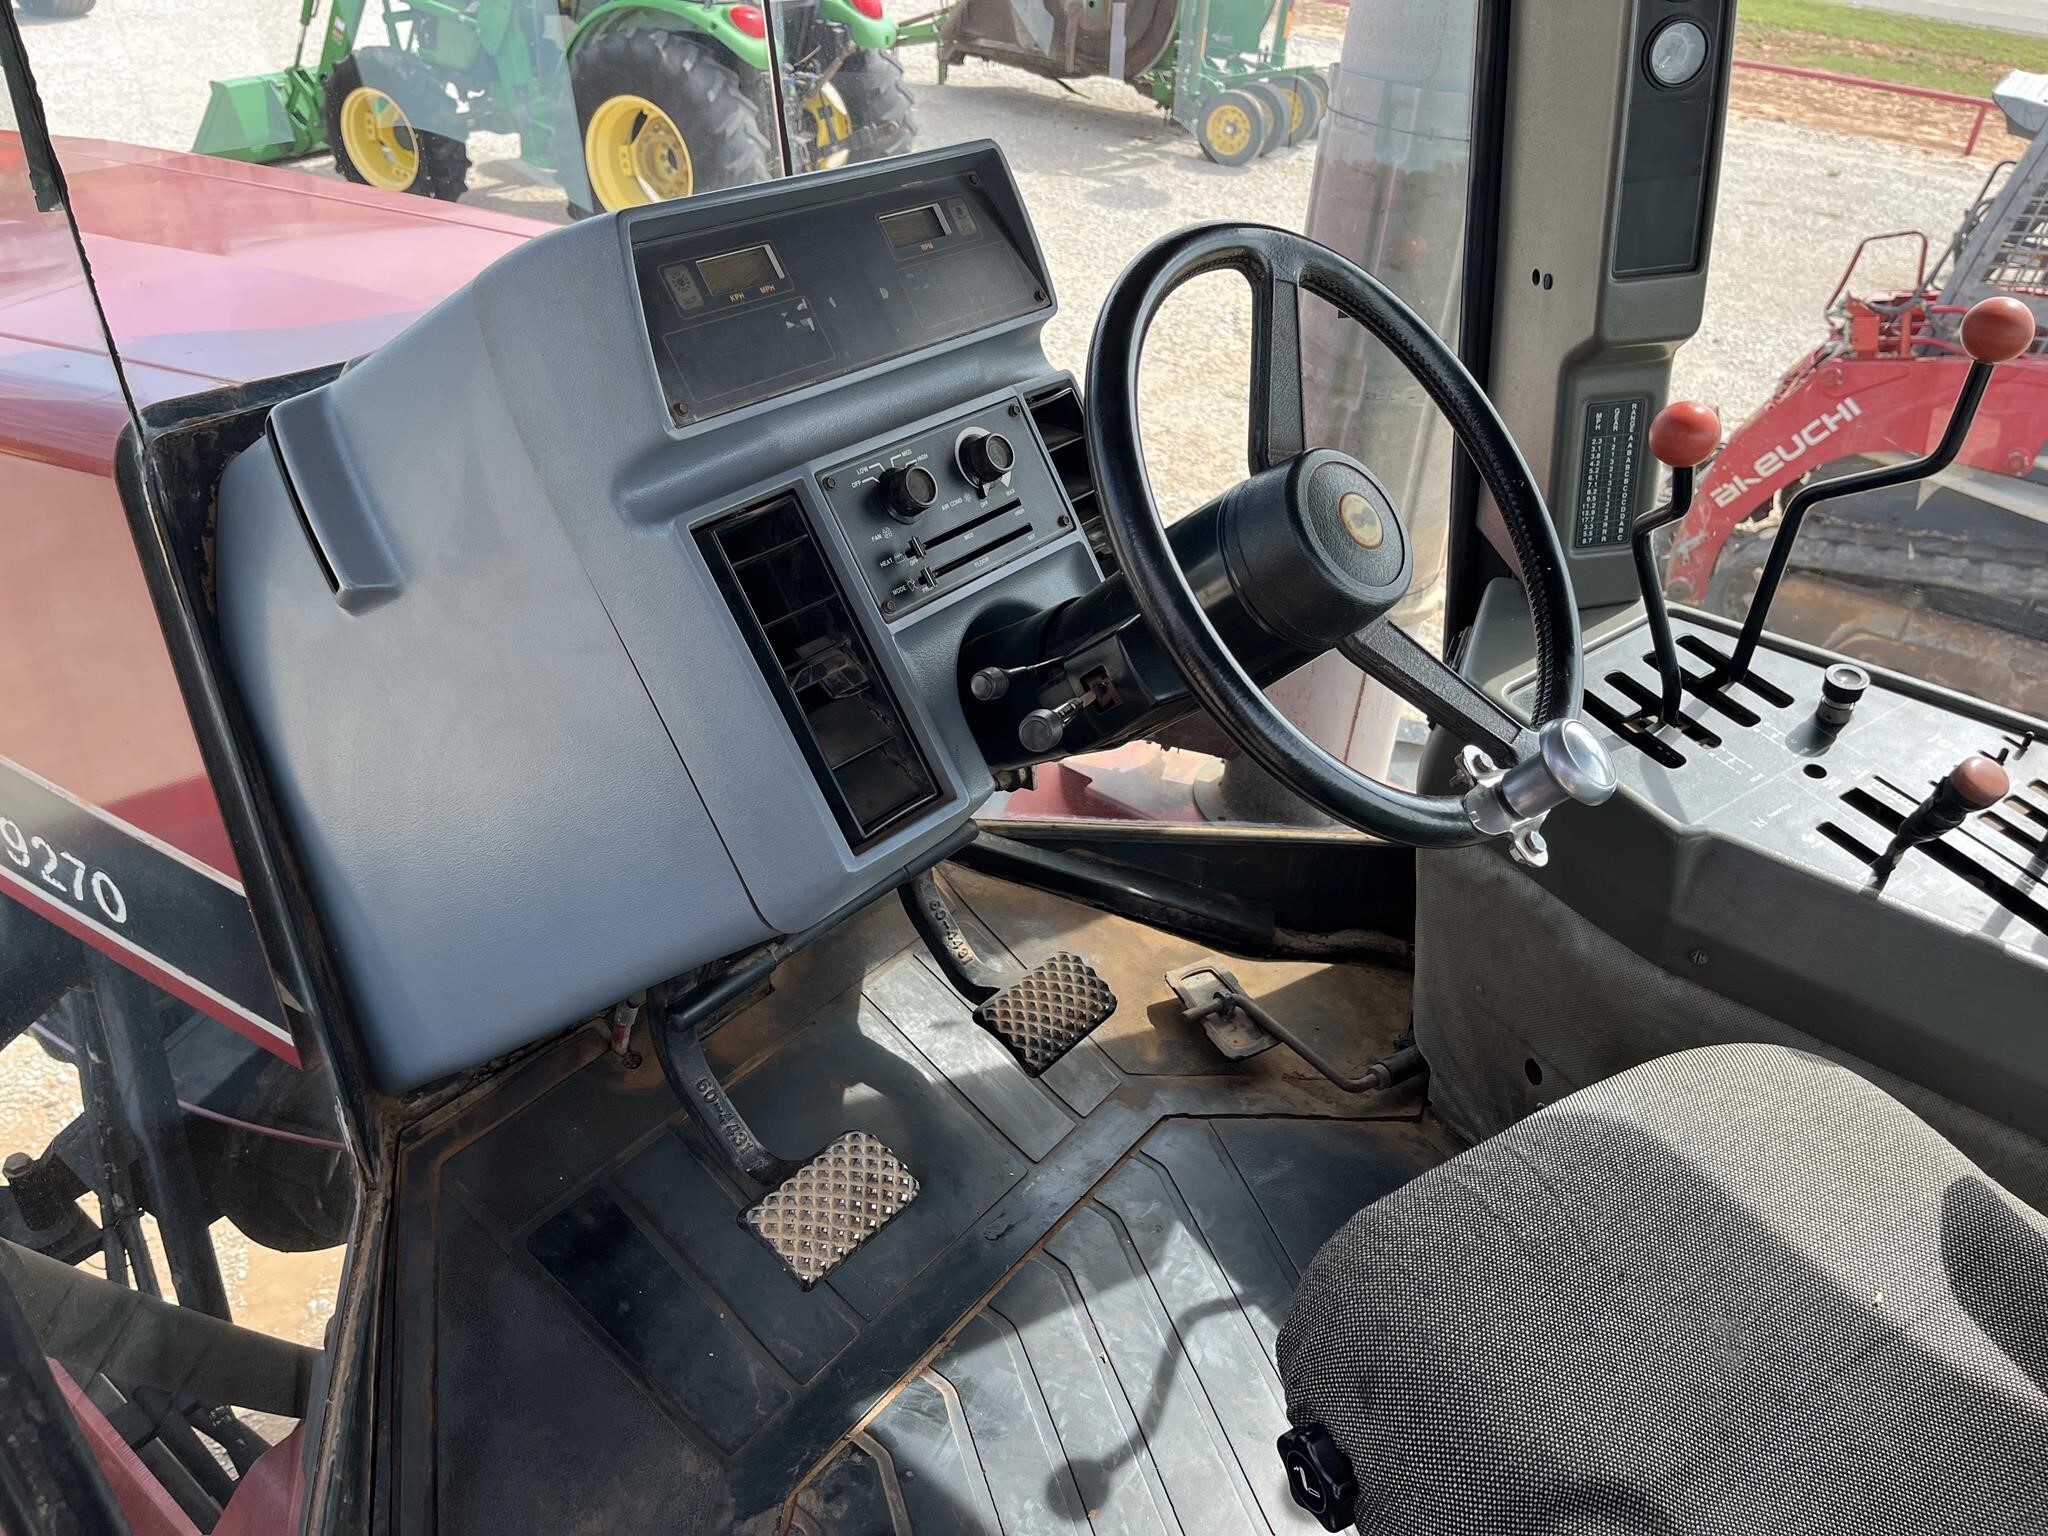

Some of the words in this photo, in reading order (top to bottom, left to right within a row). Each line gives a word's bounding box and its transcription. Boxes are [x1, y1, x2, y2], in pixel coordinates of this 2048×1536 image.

[760, 284, 776, 294] MPH
[730, 292, 745, 303] KPH
[1629, 403, 1637, 433] RANGE
[916, 453, 929, 462] HIGH
[856, 466, 869, 475] LOW
[851, 480, 861, 489] OFF
[980, 500, 989, 509] OFF
[871, 533, 882, 543] FAN
[880, 557, 893, 568] HEAT
[909, 557, 919, 567] OFF
[974, 557, 989, 568] FLOOR
[892, 584, 907, 596] MODE
[0, 817, 127, 924] 9270
